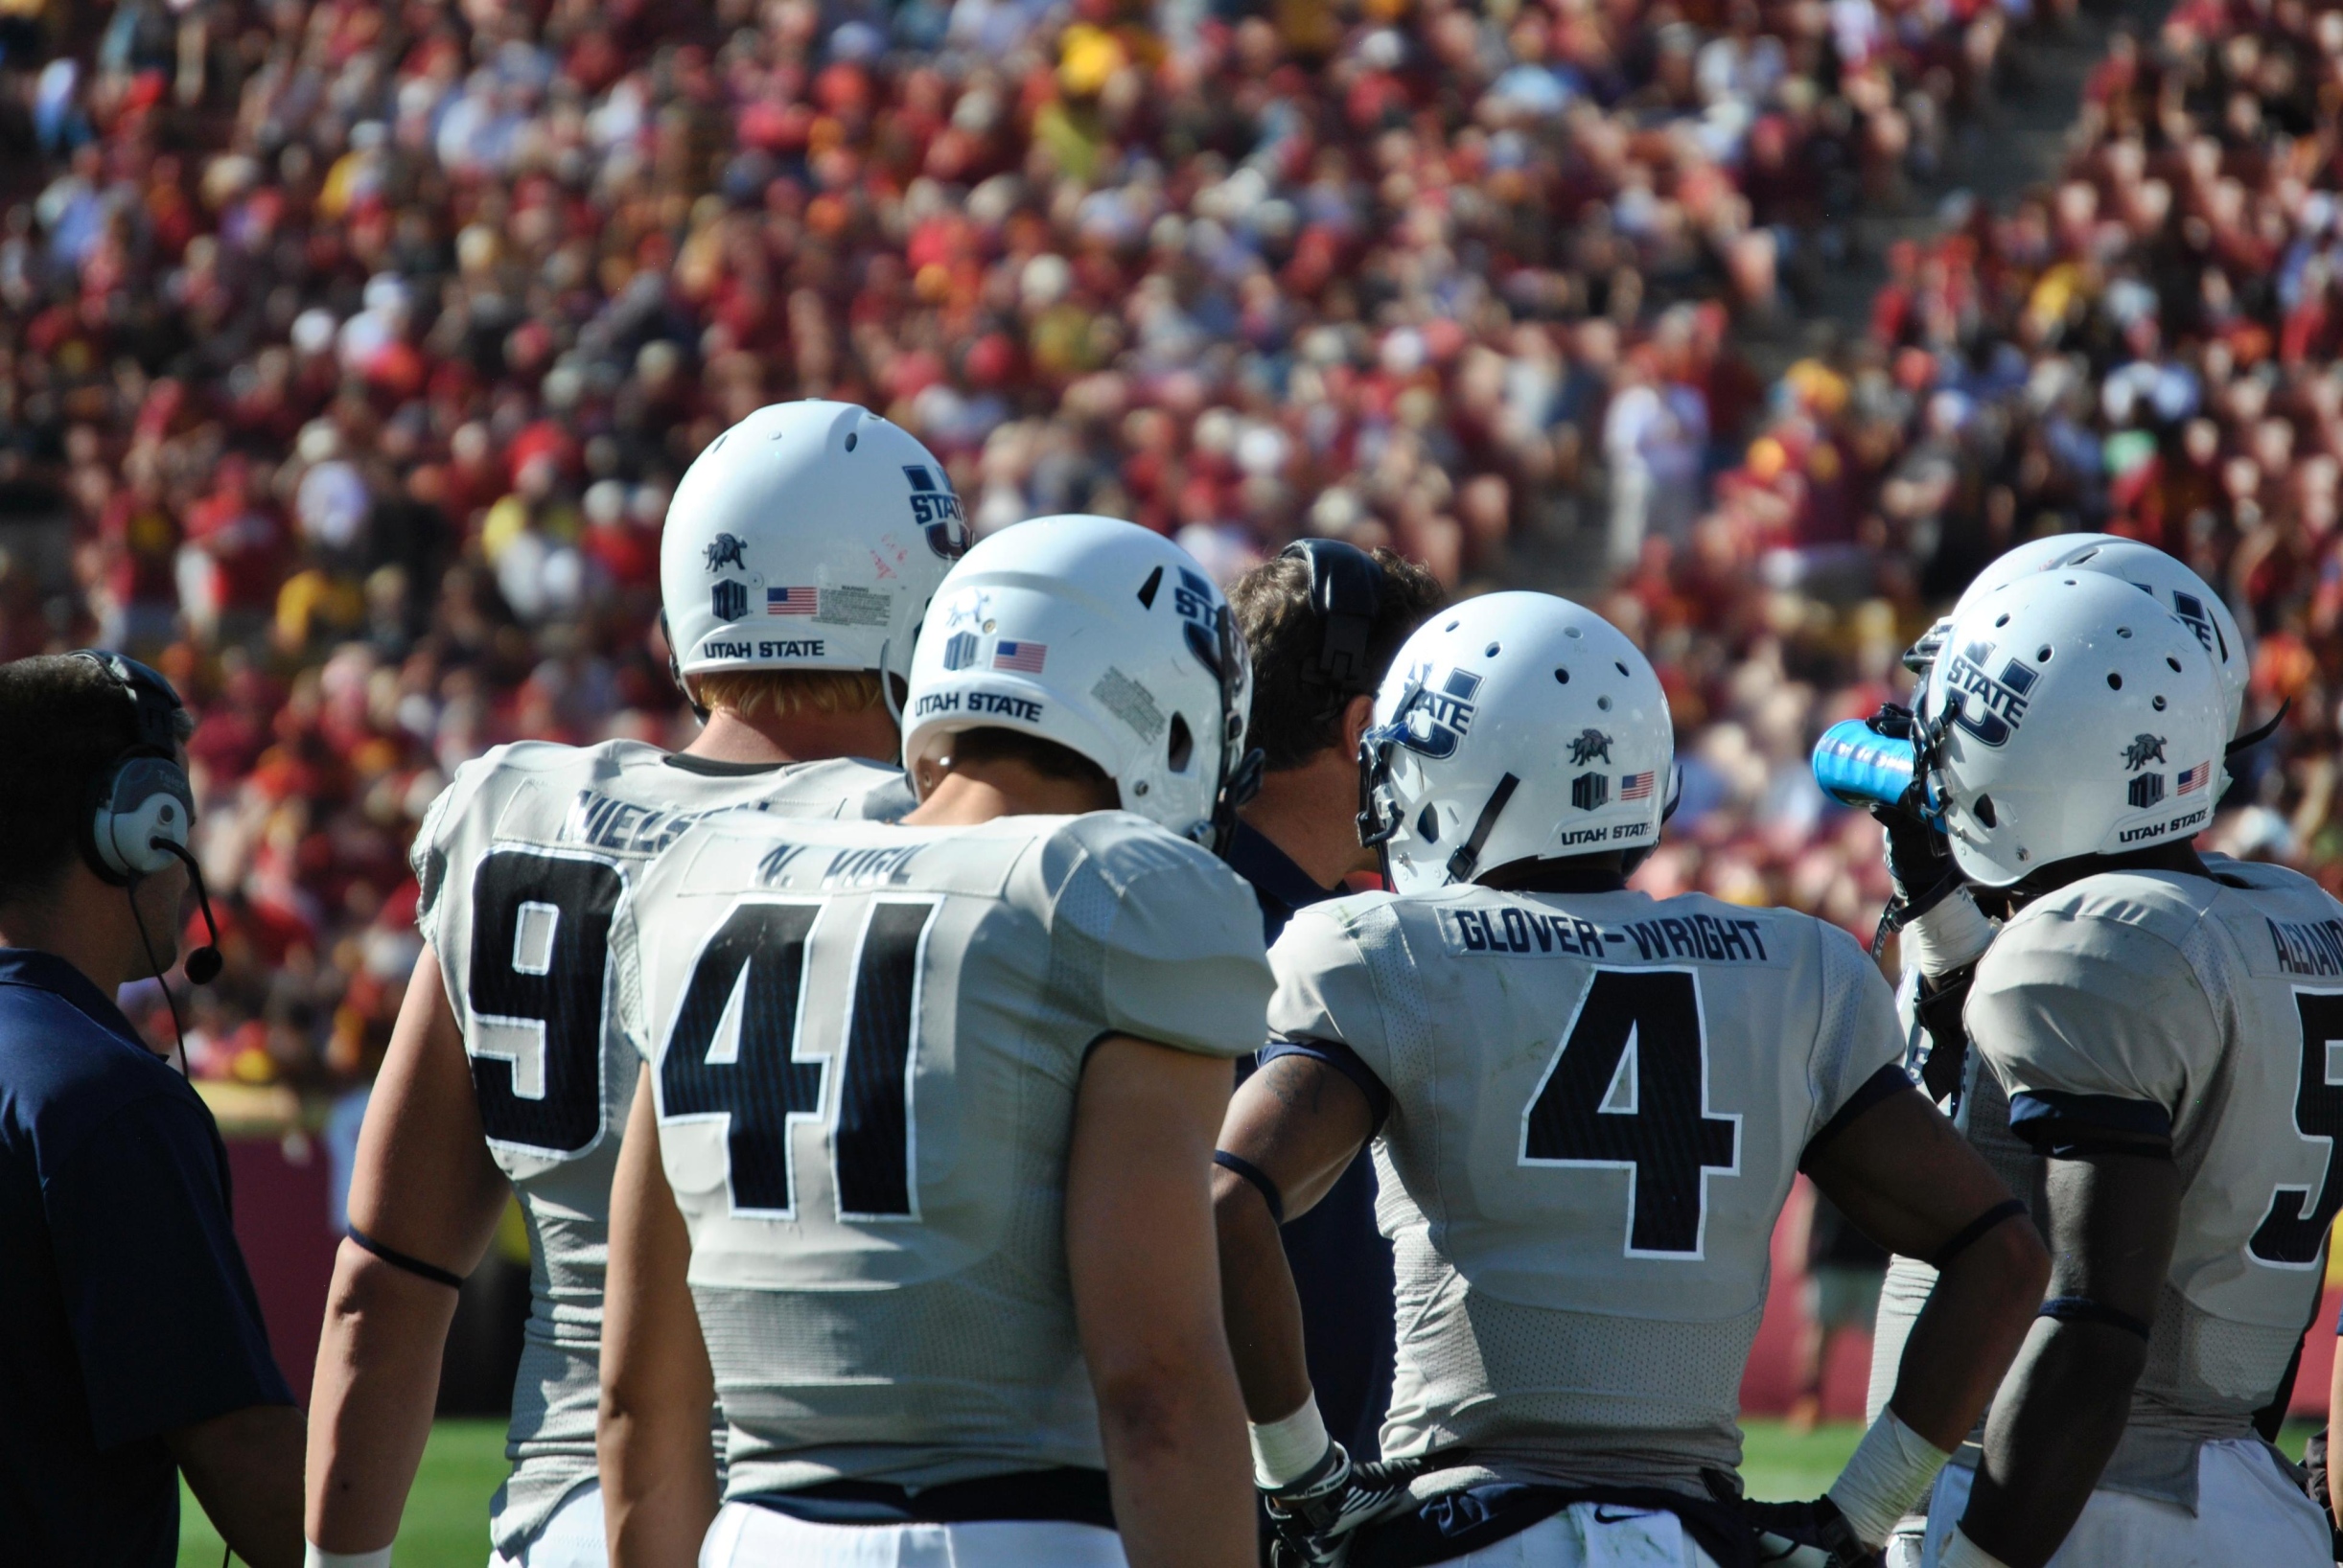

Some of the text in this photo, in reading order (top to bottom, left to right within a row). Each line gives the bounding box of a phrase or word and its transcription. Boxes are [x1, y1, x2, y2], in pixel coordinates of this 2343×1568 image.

[910, 494, 964, 524] STA
[704, 640, 824, 658] UTAH STATE
[915, 692, 1043, 723] UTAH STATE
[1947, 655, 2029, 729] STATE
[556, 790, 769, 855] NIELS
[1561, 827, 1608, 845] UTAH
[2120, 823, 2166, 842] UTAH
[747, 842, 930, 889] N. VIGIL
[1455, 907, 1768, 961] GLOVER-WRIGHT
[468, 841, 630, 1162] 9
[654, 892, 945, 1223] 41
[1518, 963, 1743, 1261] 4
